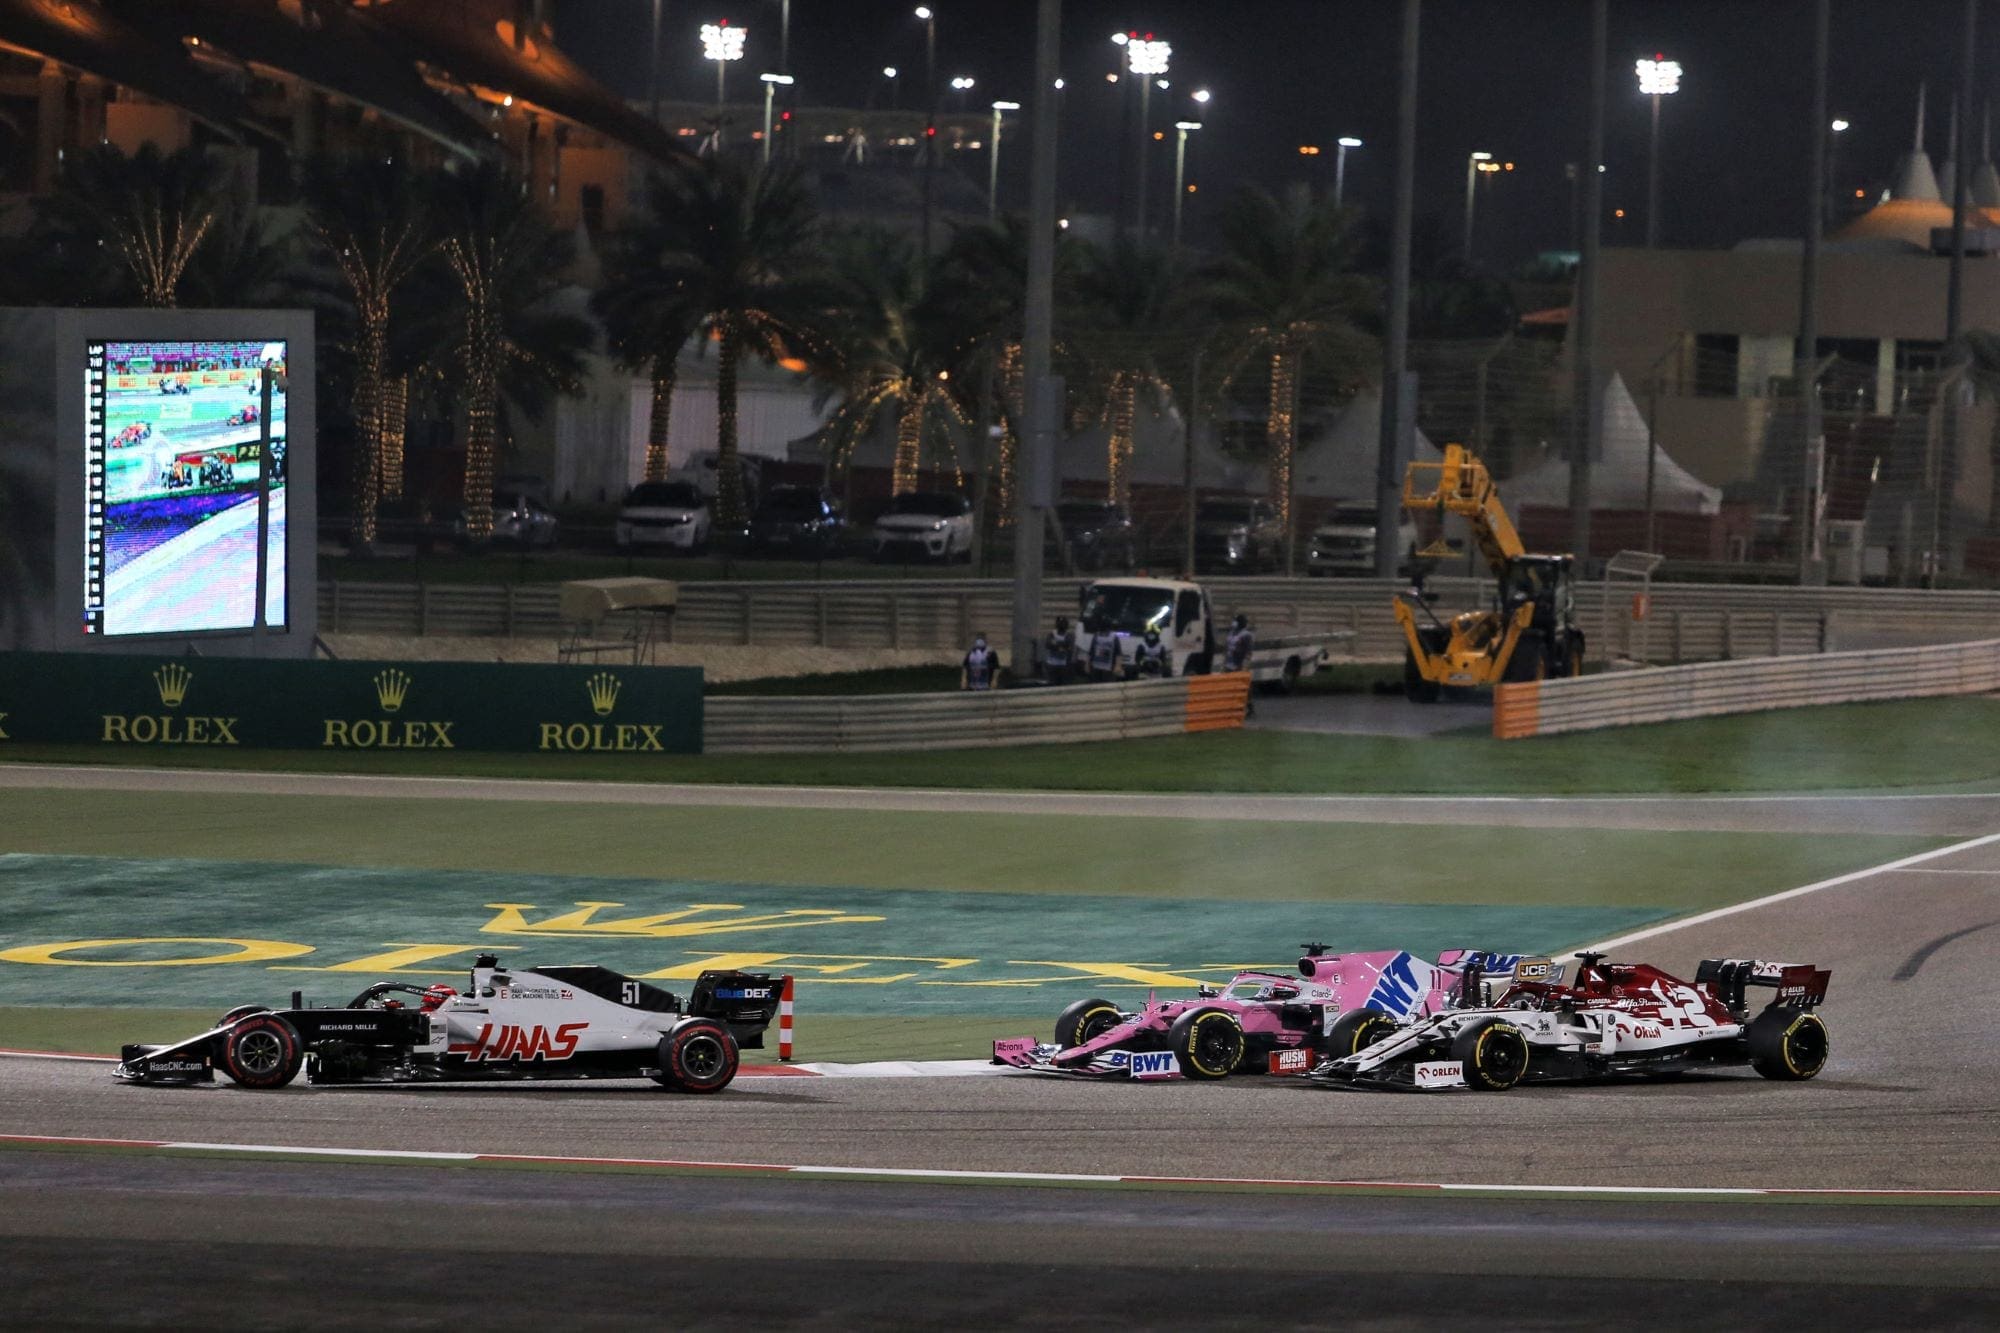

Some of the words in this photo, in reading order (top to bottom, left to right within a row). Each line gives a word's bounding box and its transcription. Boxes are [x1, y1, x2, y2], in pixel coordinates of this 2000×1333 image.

[102, 715, 240, 744] ROLEX
[323, 719, 455, 748] ROLEX
[539, 723, 664, 750] ROLEX
[1521, 965, 1547, 976] JCB
[1430, 969, 1442, 990] 11
[501, 989, 508, 999] E
[622, 982, 640, 1004] 51
[355, 1023, 378, 1031] MILLE
[448, 1022, 590, 1062] HAAS
[997, 1043, 1024, 1052] Acronis
[1132, 1053, 1174, 1073] BWT
[1280, 1050, 1307, 1063] HUSKI
[150, 1061, 202, 1072] HaasCNC.com
[1432, 1067, 1460, 1077] ORLEN
